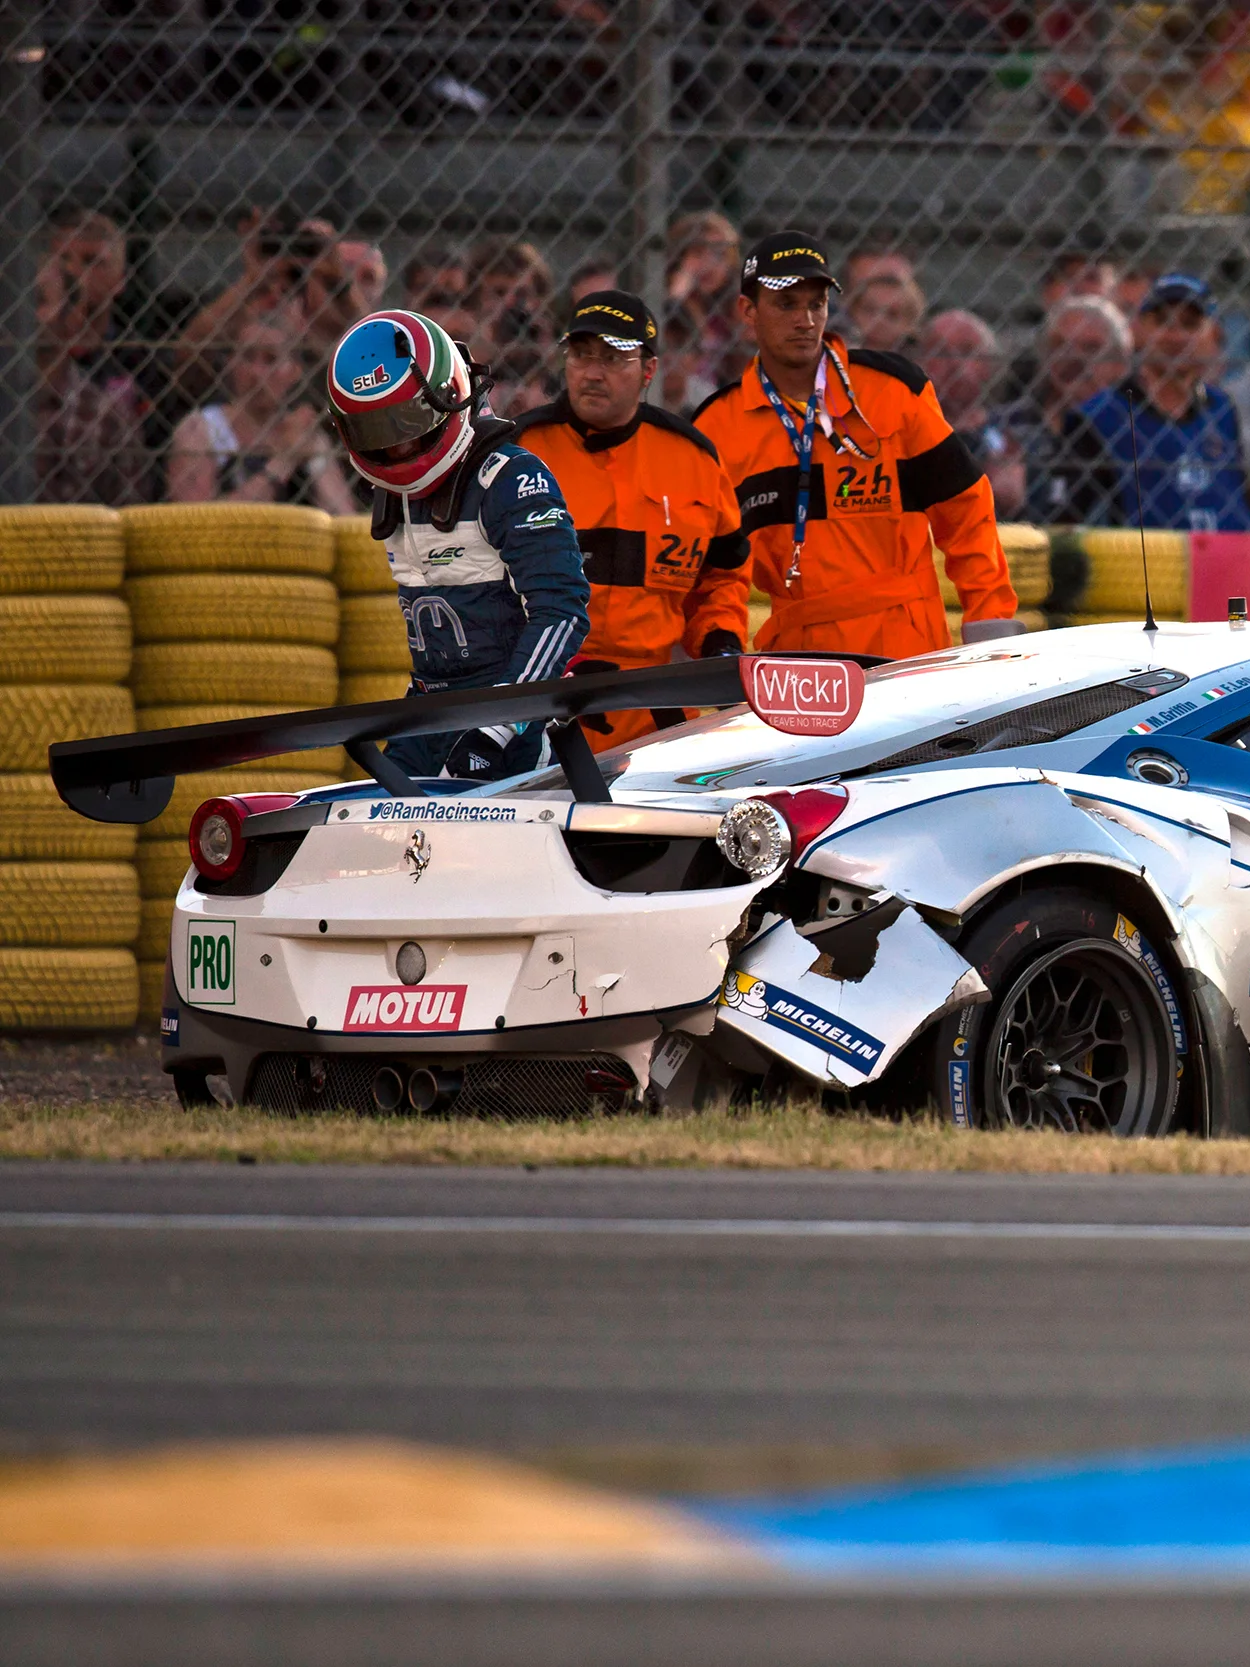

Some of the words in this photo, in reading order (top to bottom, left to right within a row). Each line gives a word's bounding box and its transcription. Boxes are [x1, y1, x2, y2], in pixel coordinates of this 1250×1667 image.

[516, 472, 549, 491] 24h
[837, 463, 891, 497] 24h
[526, 508, 565, 522] WEC
[833, 499, 848, 507] LE
[852, 495, 891, 506] MANS
[428, 547, 466, 559] WEC
[655, 534, 703, 568] 24h
[760, 669, 842, 704] Wickr
[796, 717, 810, 727] NO
[1145, 700, 1198, 728] M.Griffin
[190, 935, 231, 990] PRO
[348, 991, 457, 1025] MOTUL
[1144, 952, 1185, 1049] MICHELIN
[771, 999, 878, 1061] MICHELIN
